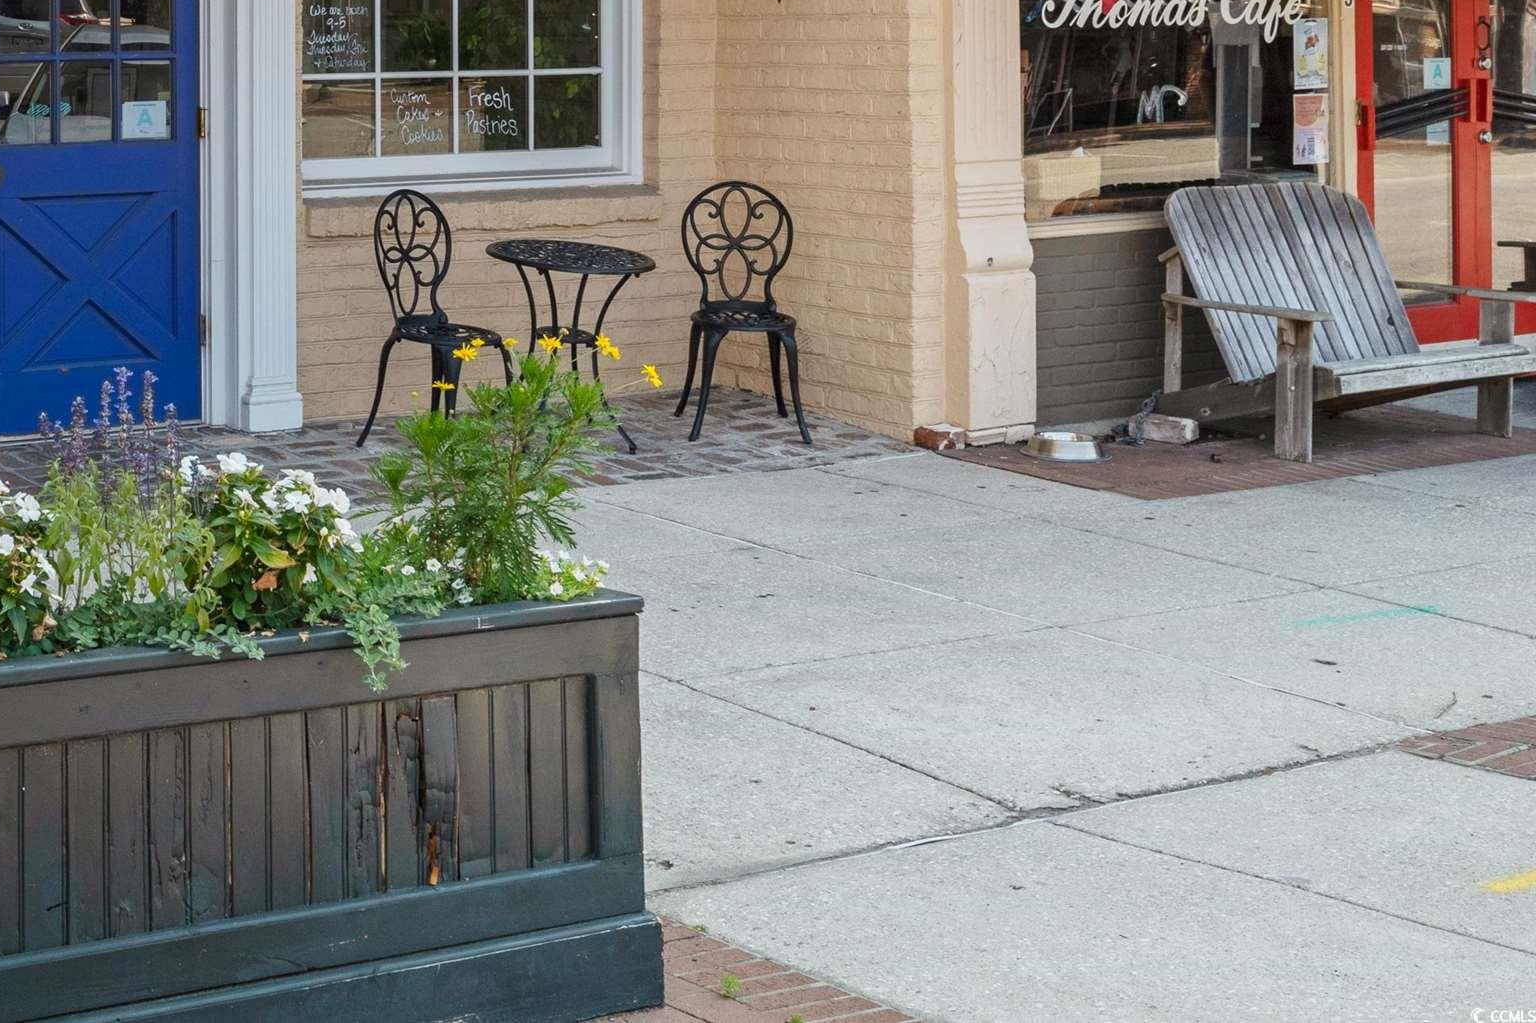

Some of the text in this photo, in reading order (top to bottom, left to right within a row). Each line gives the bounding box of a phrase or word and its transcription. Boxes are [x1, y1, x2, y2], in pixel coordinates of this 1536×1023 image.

[309, 4, 327, 16] We
[327, 16, 347, 30] 9-5
[469, 86, 514, 112] Fresh
[466, 109, 519, 137] Pastries
